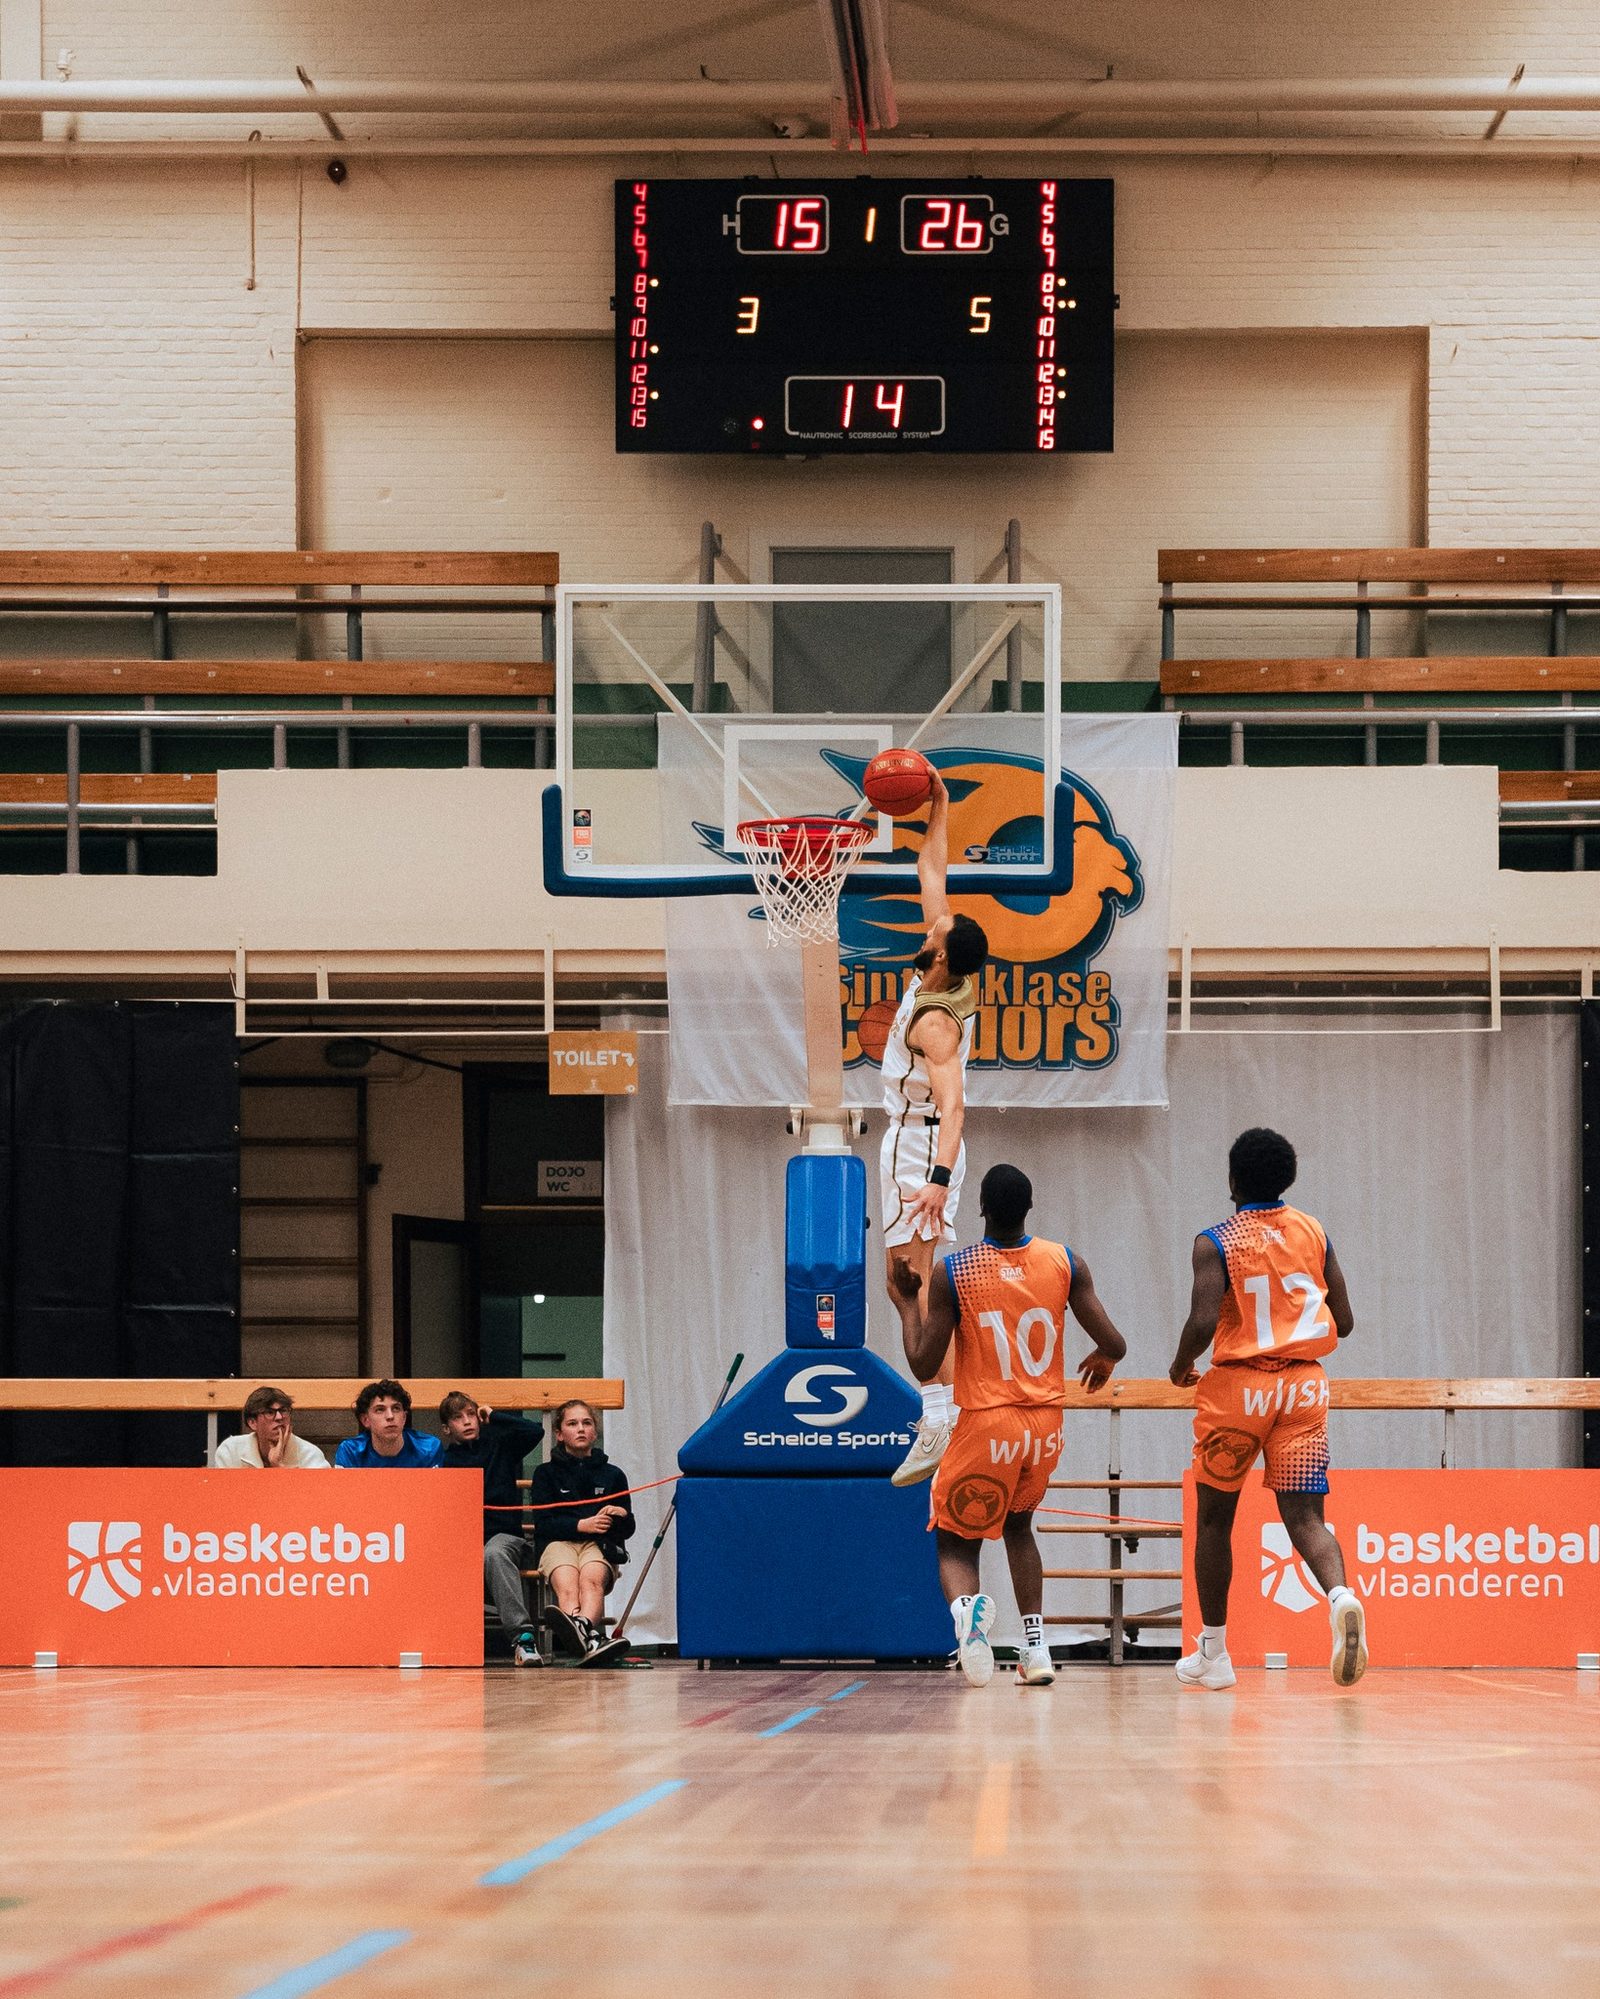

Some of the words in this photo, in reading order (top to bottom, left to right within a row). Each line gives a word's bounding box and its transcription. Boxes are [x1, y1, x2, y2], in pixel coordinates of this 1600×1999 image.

[633, 183, 647, 202] 4
[1041, 182, 1056, 201] 4
[634, 204, 647, 225] 5
[1041, 203, 1056, 225] 5
[722, 214, 741, 236] H
[775, 200, 822, 250] 15
[865, 207, 876, 242] 1
[919, 200, 983, 249] 26
[989, 213, 1010, 236] G
[633, 228, 647, 247] 6
[1040, 226, 1055, 247] 6
[635, 248, 648, 268] 7
[1043, 247, 1056, 268] 7
[634, 274, 648, 294] 8
[1040, 272, 1056, 294] 8
[634, 295, 647, 315] 9
[1041, 294, 1055, 314] 9
[736, 297, 760, 334] 3
[969, 296, 992, 333] 5
[631, 317, 648, 338] 10
[1037, 316, 1056, 338] 10
[631, 340, 648, 359] 11
[1037, 339, 1056, 358] 11
[631, 364, 648, 384] 12
[1037, 362, 1056, 384] 12
[631, 386, 648, 406] 13
[1037, 384, 1056, 406] 13
[631, 408, 648, 428] 15
[1037, 407, 1056, 427] 14
[800, 431, 844, 439] NAUTRONIC
[849, 431, 898, 439] SCOREBOARD
[902, 431, 931, 439] SYSTEM
[1037, 428, 1056, 450] 15
[553, 1049, 621, 1067] TOILET
[546, 1166, 586, 1178] DOJO
[546, 1181, 571, 1193] WC
[1244, 1271, 1330, 1350] 12
[978, 1307, 1058, 1381] 10
[743, 1431, 833, 1446] Schelde
[837, 1431, 911, 1450] Sports
[163, 1522, 405, 1563] basketbal
[1356, 1523, 1600, 1564] basketbal
[151, 1566, 369, 1597] .vlaanderen
